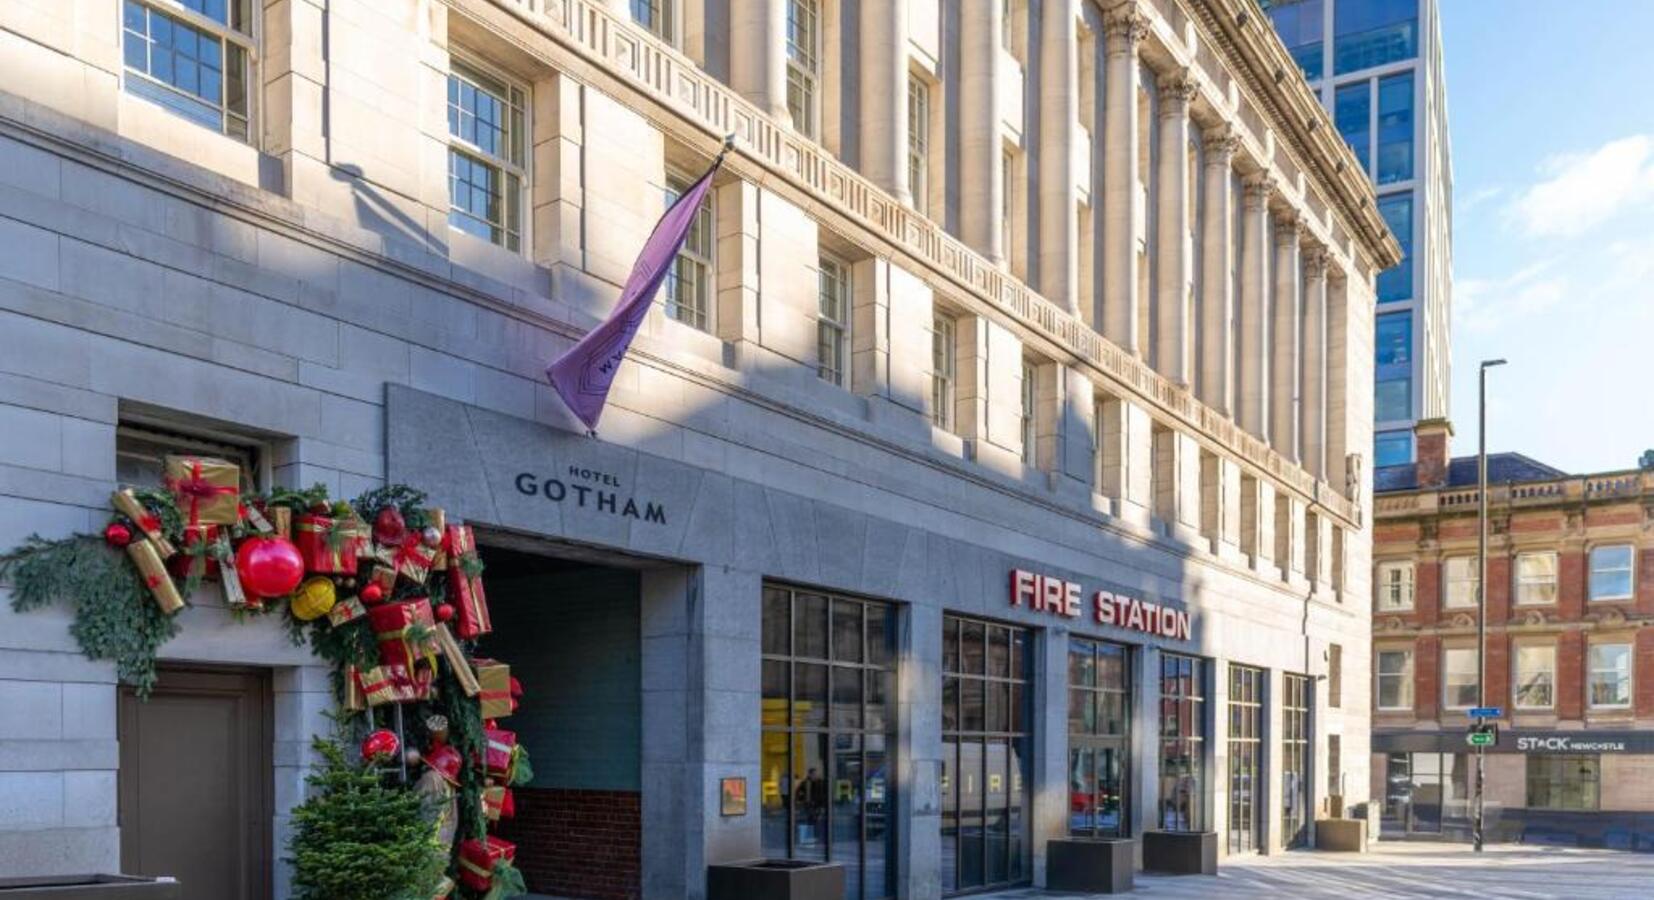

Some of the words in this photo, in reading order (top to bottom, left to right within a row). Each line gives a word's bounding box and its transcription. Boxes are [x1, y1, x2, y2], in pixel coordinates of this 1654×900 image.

[569, 465, 620, 488] HOTEL
[515, 473, 666, 524] GOTHAM
[1010, 569, 1082, 616] FIRE
[1094, 590, 1192, 641] STATION
[1517, 737, 1570, 750] STACK
